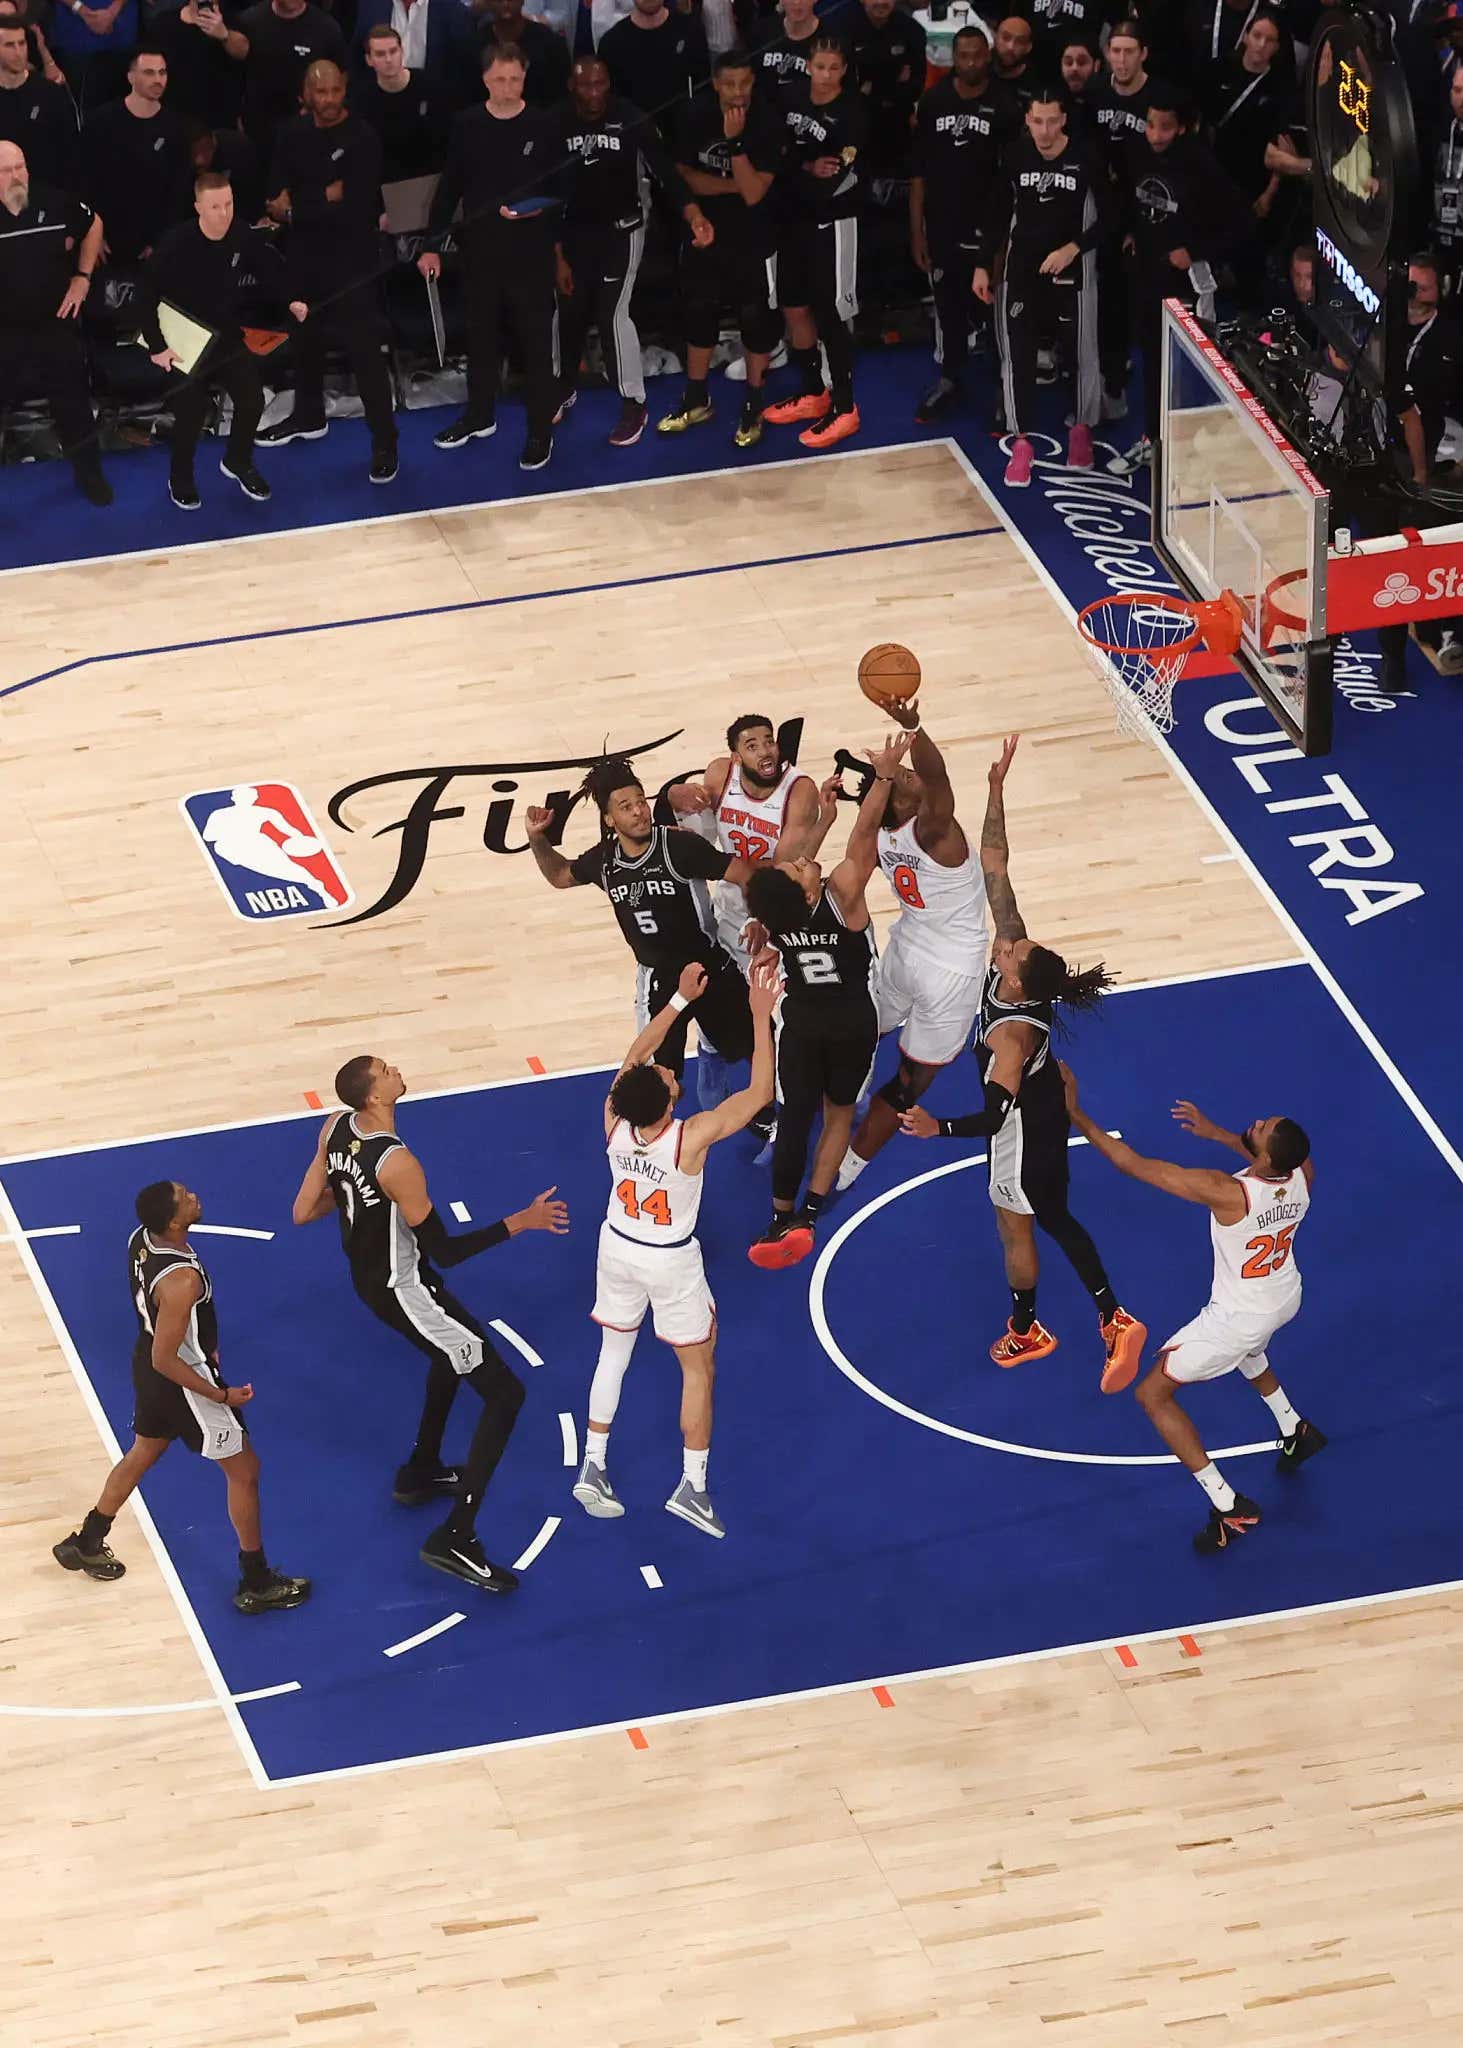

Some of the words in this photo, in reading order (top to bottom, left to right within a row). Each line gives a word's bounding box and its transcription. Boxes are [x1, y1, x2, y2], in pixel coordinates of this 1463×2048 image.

[761, 52, 813, 75] SPUR
[935, 114, 991, 137] SPURS
[1019, 171, 1077, 194] SPURS
[720, 806, 750, 827] NEW
[746, 812, 781, 841] YORK
[1203, 696, 1425, 926] ULTRA
[728, 830, 769, 861] 32
[244, 885, 310, 915] NBA
[610, 880, 676, 907] SPURS
[894, 864, 925, 909] 8
[633, 910, 659, 934] 5
[778, 932, 839, 947] HARPER
[797, 951, 842, 984] 2
[326, 1152, 381, 1208] MBANYAMA
[616, 1154, 668, 1184] SHAMET
[341, 1179, 355, 1229] 1
[616, 1178, 672, 1226] 44
[1256, 1202, 1302, 1230] BRIDGES
[1241, 1221, 1299, 1279] 25
